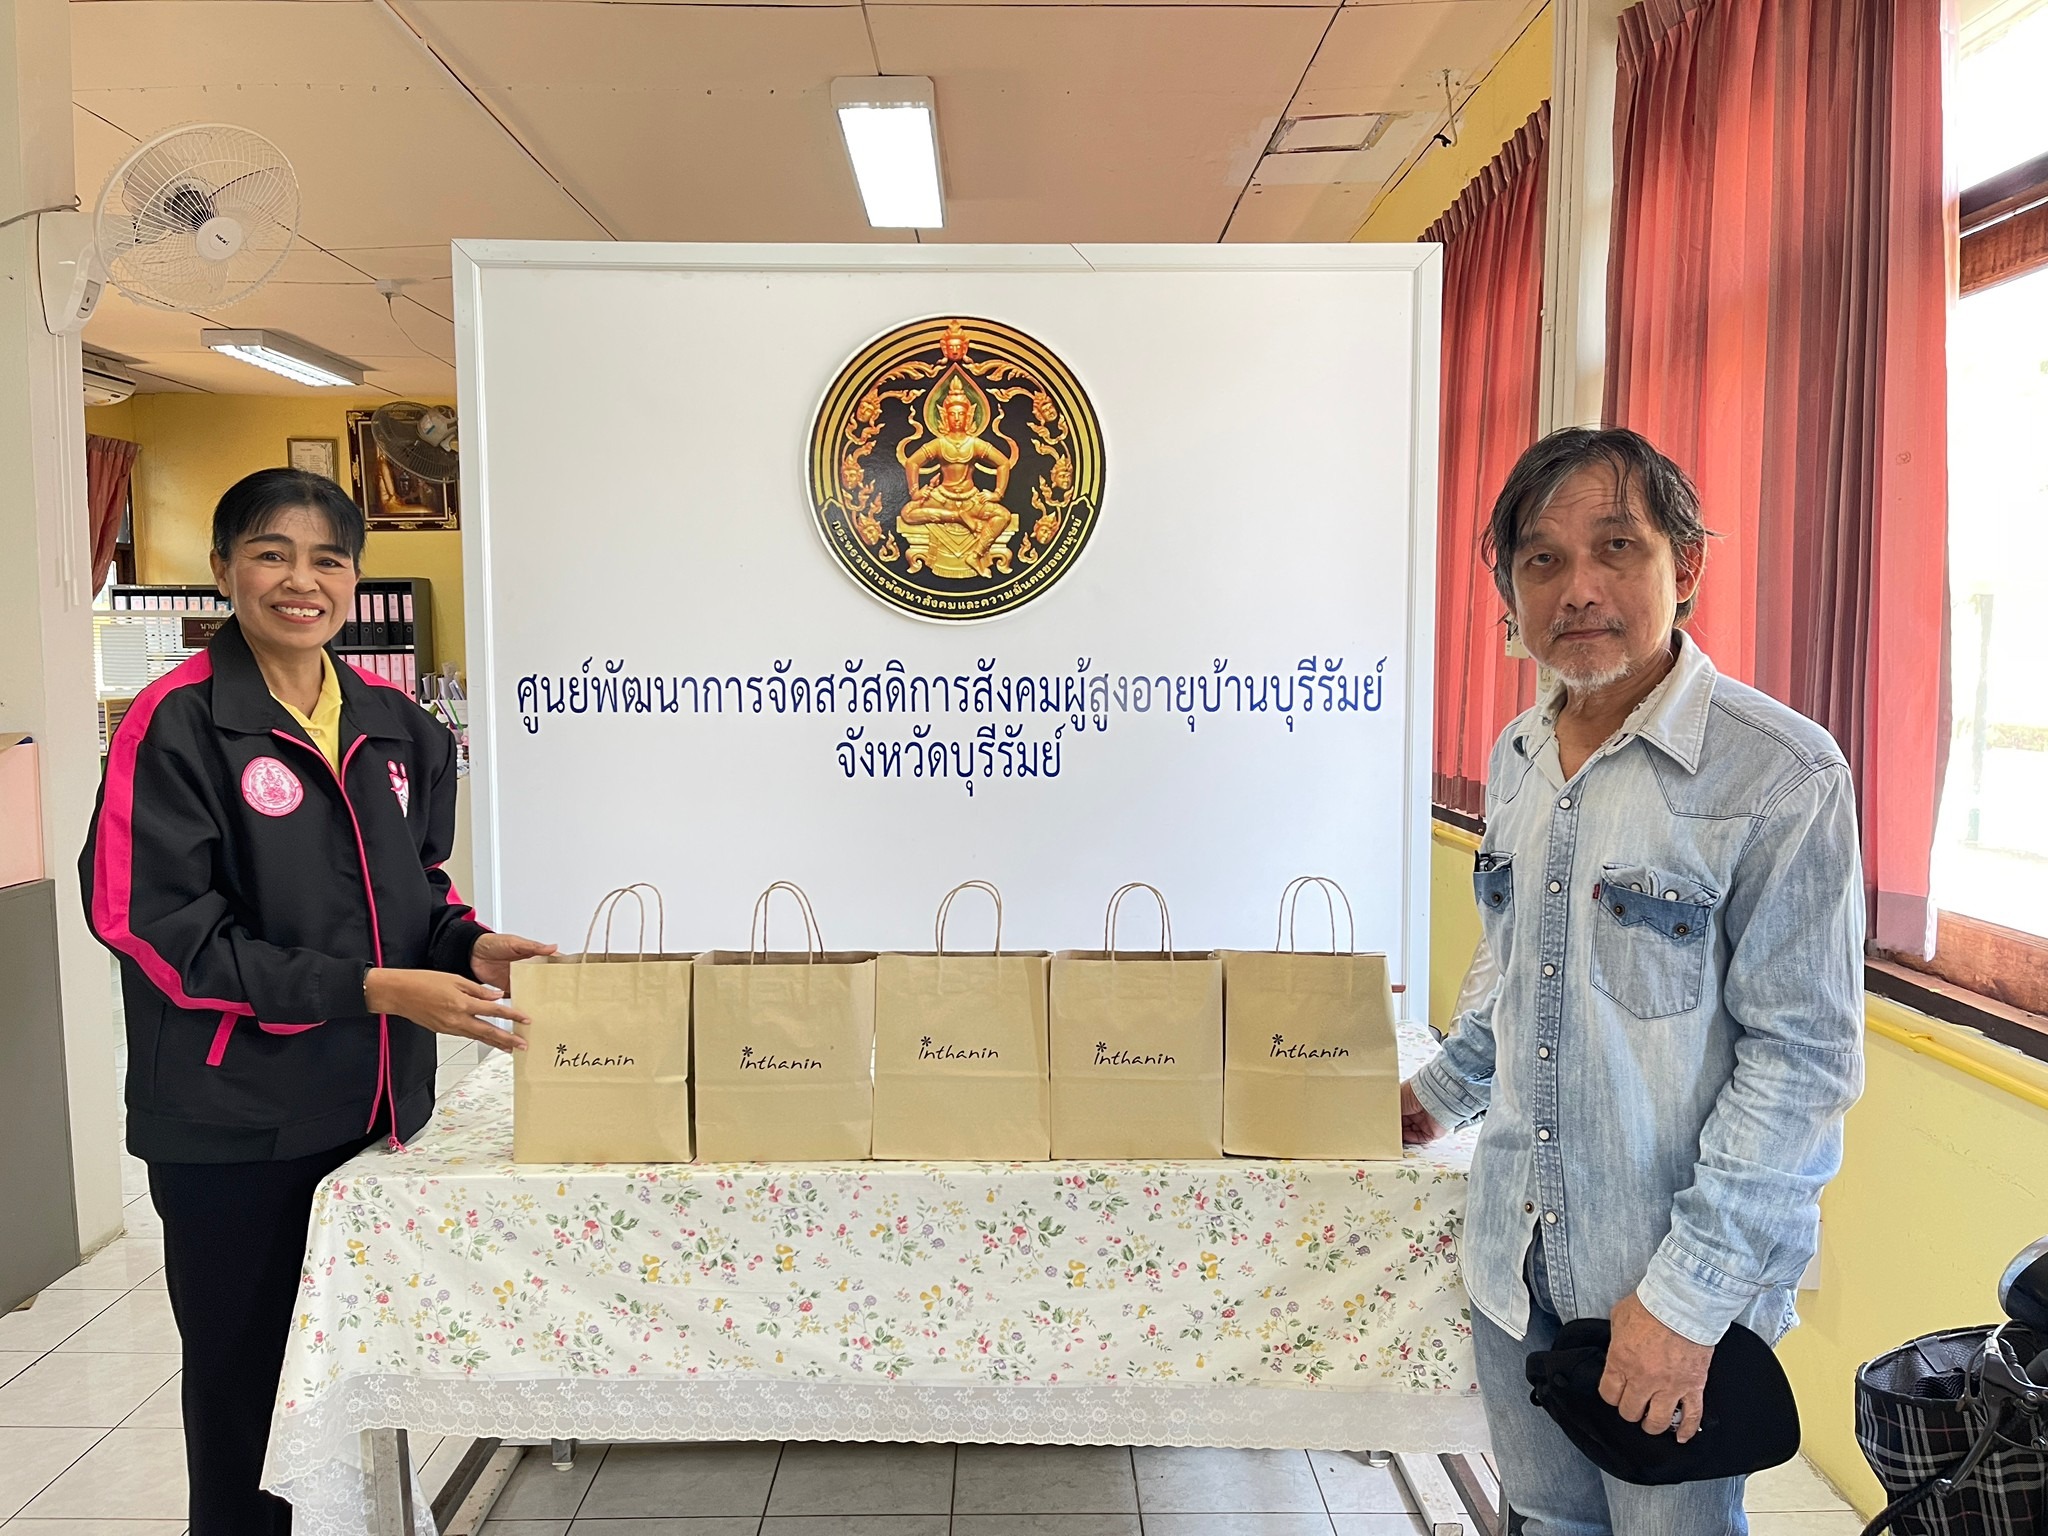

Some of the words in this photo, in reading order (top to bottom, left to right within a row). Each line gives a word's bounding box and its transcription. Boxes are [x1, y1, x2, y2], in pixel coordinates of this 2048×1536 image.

[516, 655, 1388, 735] ศูนย์พัฒนาการจัดสวัสดิการสังคมผู้สูงอายุบ้านบุรีรัมย์
[835, 723, 1066, 798] จังหวัดบุรีรัมย์
[553, 1044, 635, 1068] inthanin
[739, 1046, 822, 1070] inthanin
[918, 1036, 999, 1060] inthanin
[1093, 1042, 1176, 1066] inthanin
[1269, 1034, 1349, 1059] inthanin
